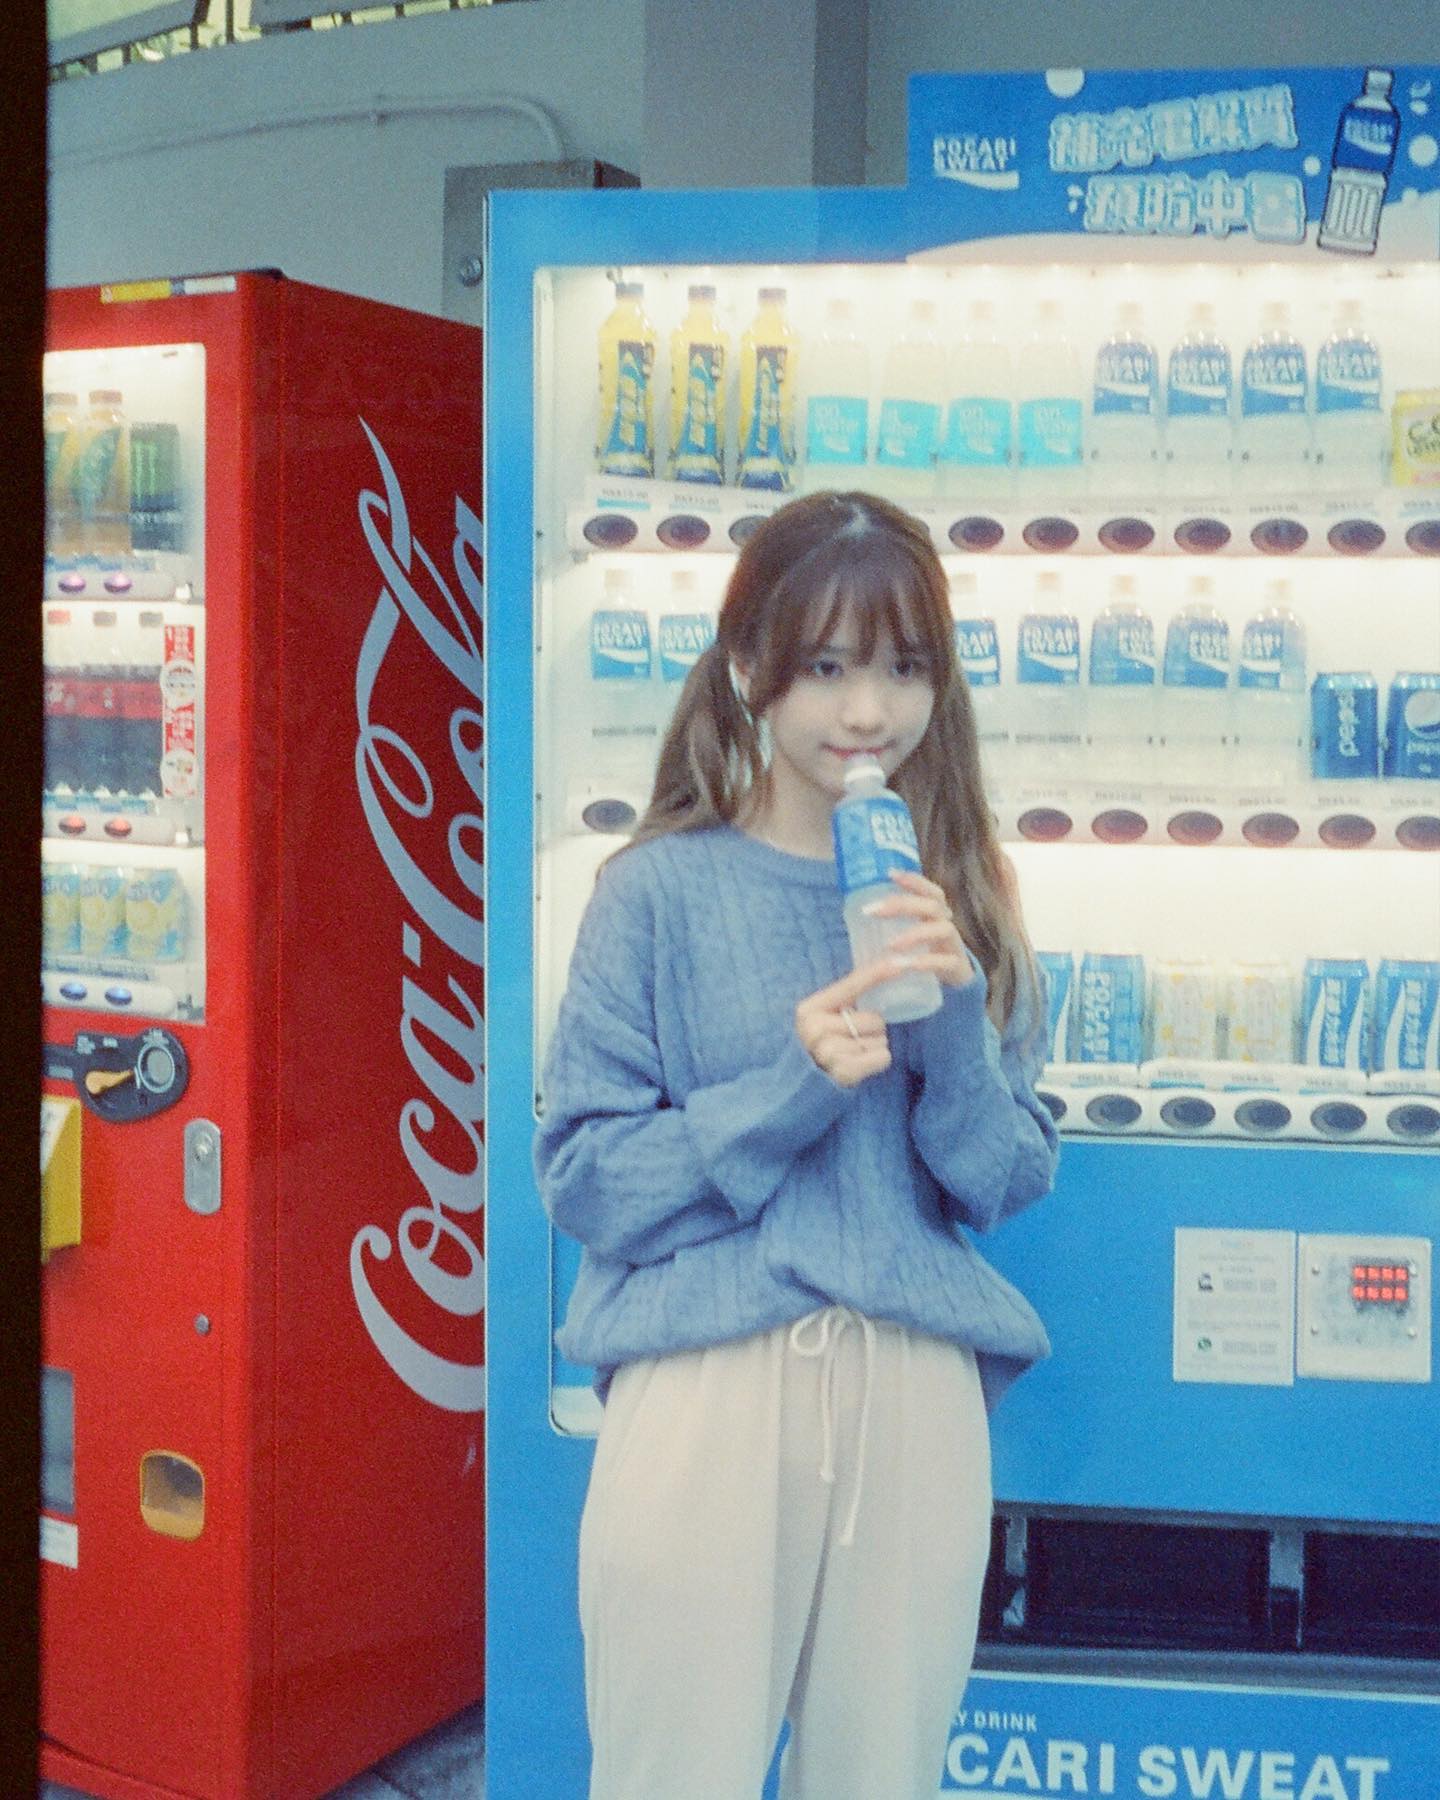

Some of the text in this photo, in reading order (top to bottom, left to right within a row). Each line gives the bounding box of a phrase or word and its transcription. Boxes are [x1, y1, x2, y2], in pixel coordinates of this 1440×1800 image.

[933, 137, 1016, 156] POCARI
[974, 1710, 1038, 1732] DRINK
[1137, 1744, 1390, 1800] SWEAT
